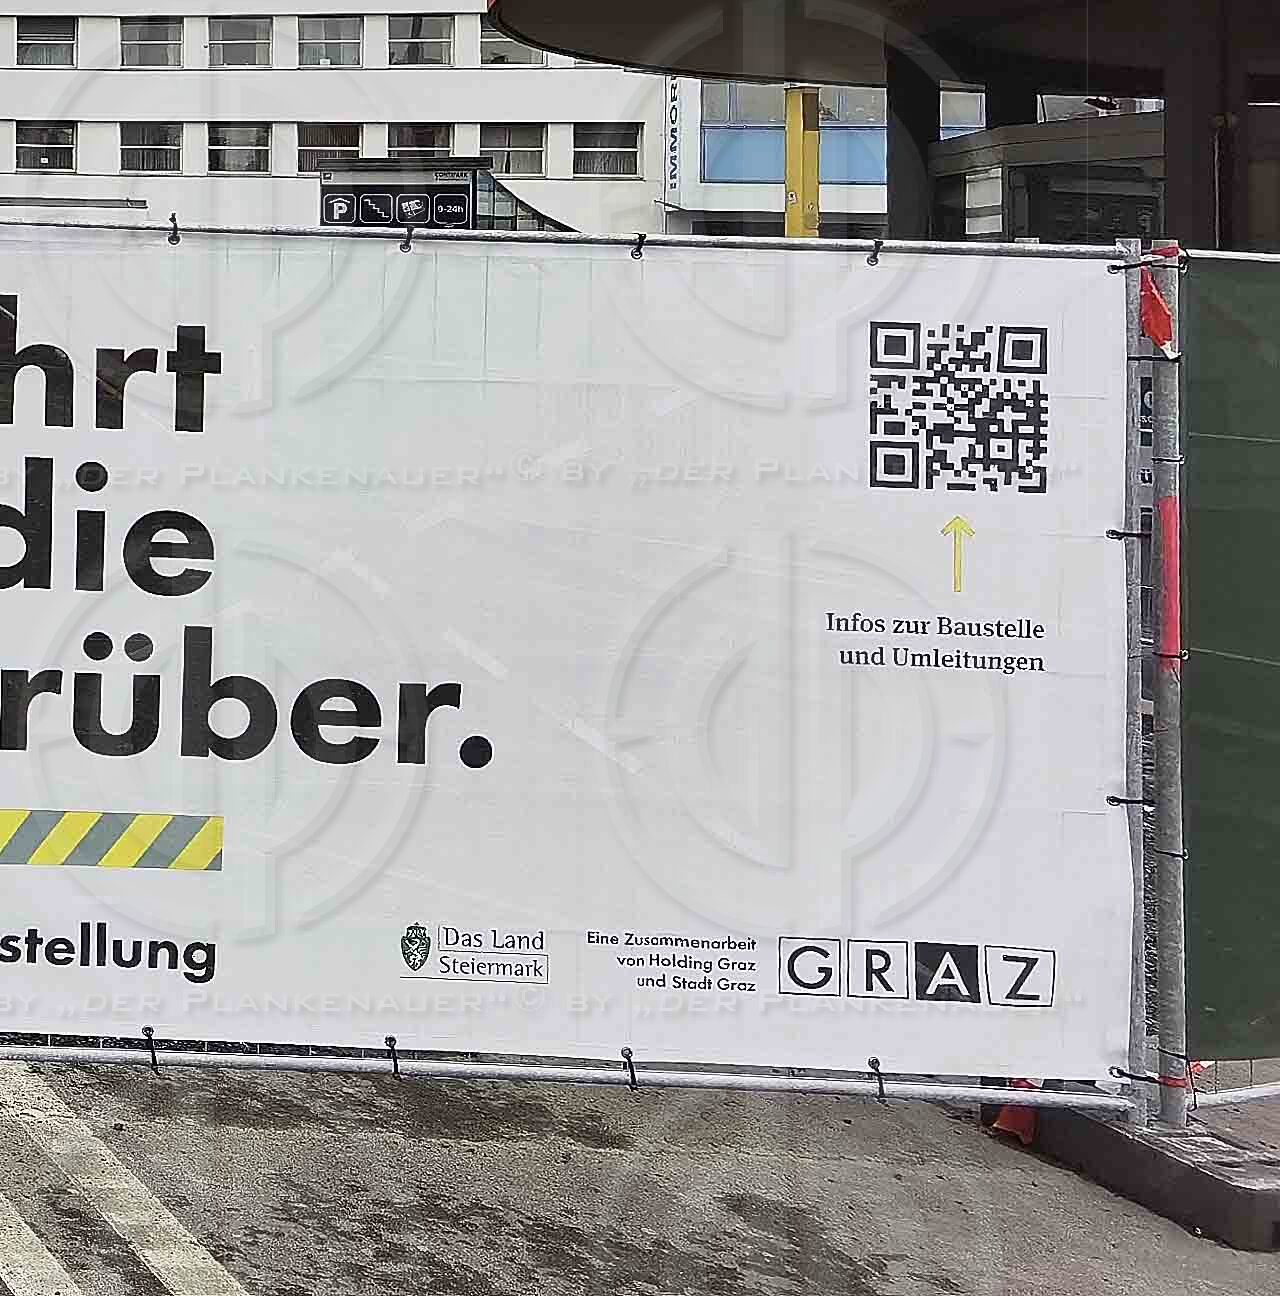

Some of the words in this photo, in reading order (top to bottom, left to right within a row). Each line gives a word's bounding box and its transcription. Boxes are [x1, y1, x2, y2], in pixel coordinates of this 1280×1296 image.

[825, 613, 886, 633] Infos
[893, 619, 931, 635] zur
[936, 615, 1045, 639] Baustelle
[839, 647, 885, 666] und
[892, 648, 1045, 674] Umleitungen
[443, 926, 486, 950] Das
[491, 927, 545, 952] Land
[587, 931, 619, 947] Eine
[624, 932, 757, 952] Zusammenarbeit
[440, 955, 544, 979] Steiermark
[616, 956, 644, 971] von
[649, 951, 713, 975] Holding
[716, 957, 757, 973] Graz
[786, 944, 1041, 1002] GRAZ
[637, 975, 667, 991] und
[672, 975, 712, 992] Stadt
[716, 977, 757, 993] Graz
